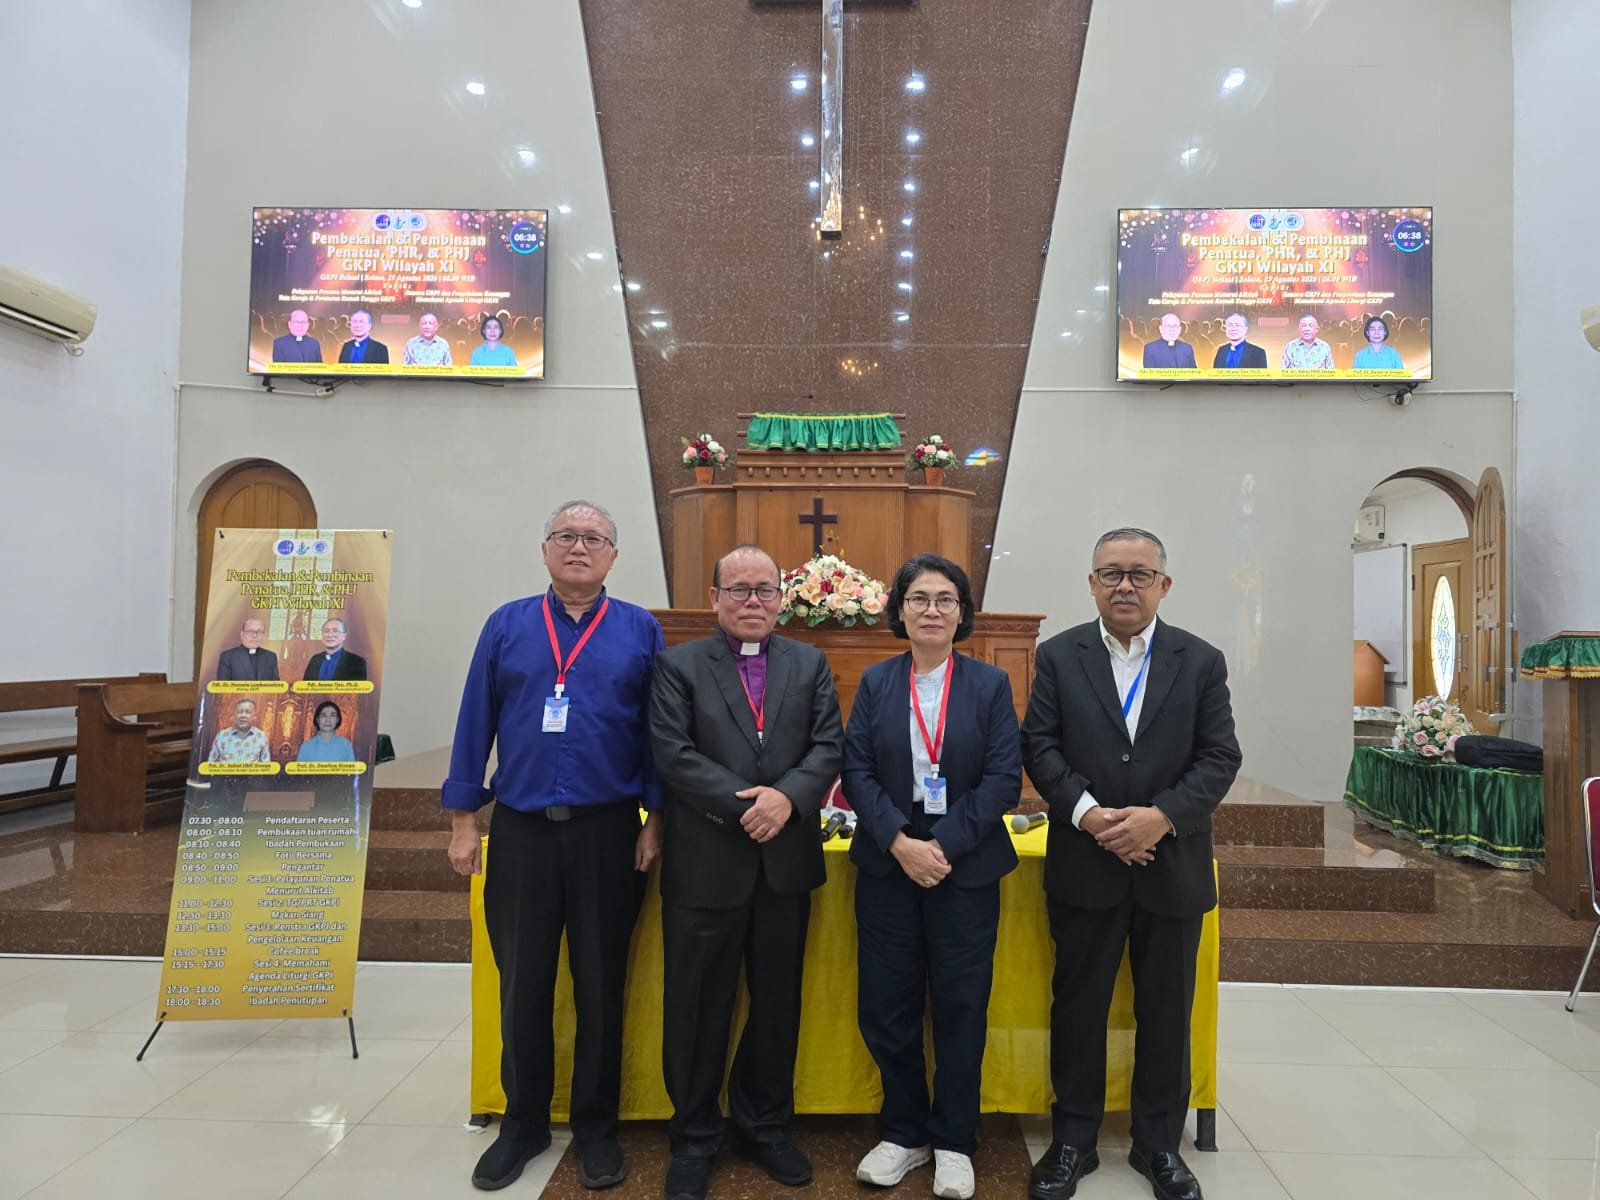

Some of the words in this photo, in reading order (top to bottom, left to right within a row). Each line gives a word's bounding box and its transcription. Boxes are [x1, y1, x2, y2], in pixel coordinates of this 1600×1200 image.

[311, 232, 392, 245] Pembekalan
[396, 233, 408, 245] &
[412, 233, 486, 246] Pembinaan
[1182, 233, 1268, 246] Pembekalan
[1271, 234, 1286, 245] &
[1290, 233, 1368, 246] Pembinaan
[1398, 232, 1421, 240] 06:38
[327, 245, 386, 260] Penatua,
[389, 246, 424, 261] PHR,
[427, 247, 440, 259] &
[445, 246, 470, 261] PHJ
[1199, 247, 1261, 261] Penatua,
[1266, 246, 1301, 261] PHR,
[1306, 247, 1320, 259] &
[1324, 246, 1350, 261] PHJ
[342, 259, 377, 272] GKPI
[382, 260, 435, 274] Wilayah
[439, 260, 454, 273] XI
[1216, 261, 1253, 274] GKPI
[1257, 260, 1314, 276] Wilayah
[1318, 261, 1335, 274] XI
[226, 569, 296, 582] Pembekalan
[310, 569, 374, 582] Pembinaan
[241, 583, 290, 597] Penatua,
[333, 584, 358, 595] PHJ
[251, 597, 283, 609] GKPI
[283, 597, 331, 610] Wilayah
[331, 597, 345, 609] XI
[265, 816, 318, 825] Pendaftaran
[318, 816, 350, 824] Peserta
[257, 828, 306, 836] Pembukaan
[328, 828, 356, 836] rumah
[266, 840, 294, 848] Ibadah
[296, 840, 345, 848] Pembukaan
[275, 851, 294, 859] Foto
[296, 851, 332, 859] Bersama
[281, 863, 324, 872] Pengantar
[248, 875, 266, 883] Sesi
[276, 875, 319, 884] Pelayanan
[320, 874, 354, 882] Penatua
[266, 887, 302, 895] Menurut
[304, 886, 334, 895] Alkitab
[258, 899, 274, 907] Sesi
[271, 911, 300, 919] Makan
[246, 923, 263, 931] Sesi
[248, 935, 300, 945] Pengelolaan
[301, 935, 343, 944] Keuangan
[254, 960, 272, 968] Sesi
[283, 959, 330, 967] Memahami
[249, 972, 281, 981] Agenda
[283, 972, 310, 981] Liturgi
[312, 971, 333, 979] GKPI
[242, 985, 293, 994] Penyerahan
[295, 983, 334, 992] Sertifikat
[249, 997, 279, 1005] Ibadah
[281, 997, 328, 1006] Penutupan
